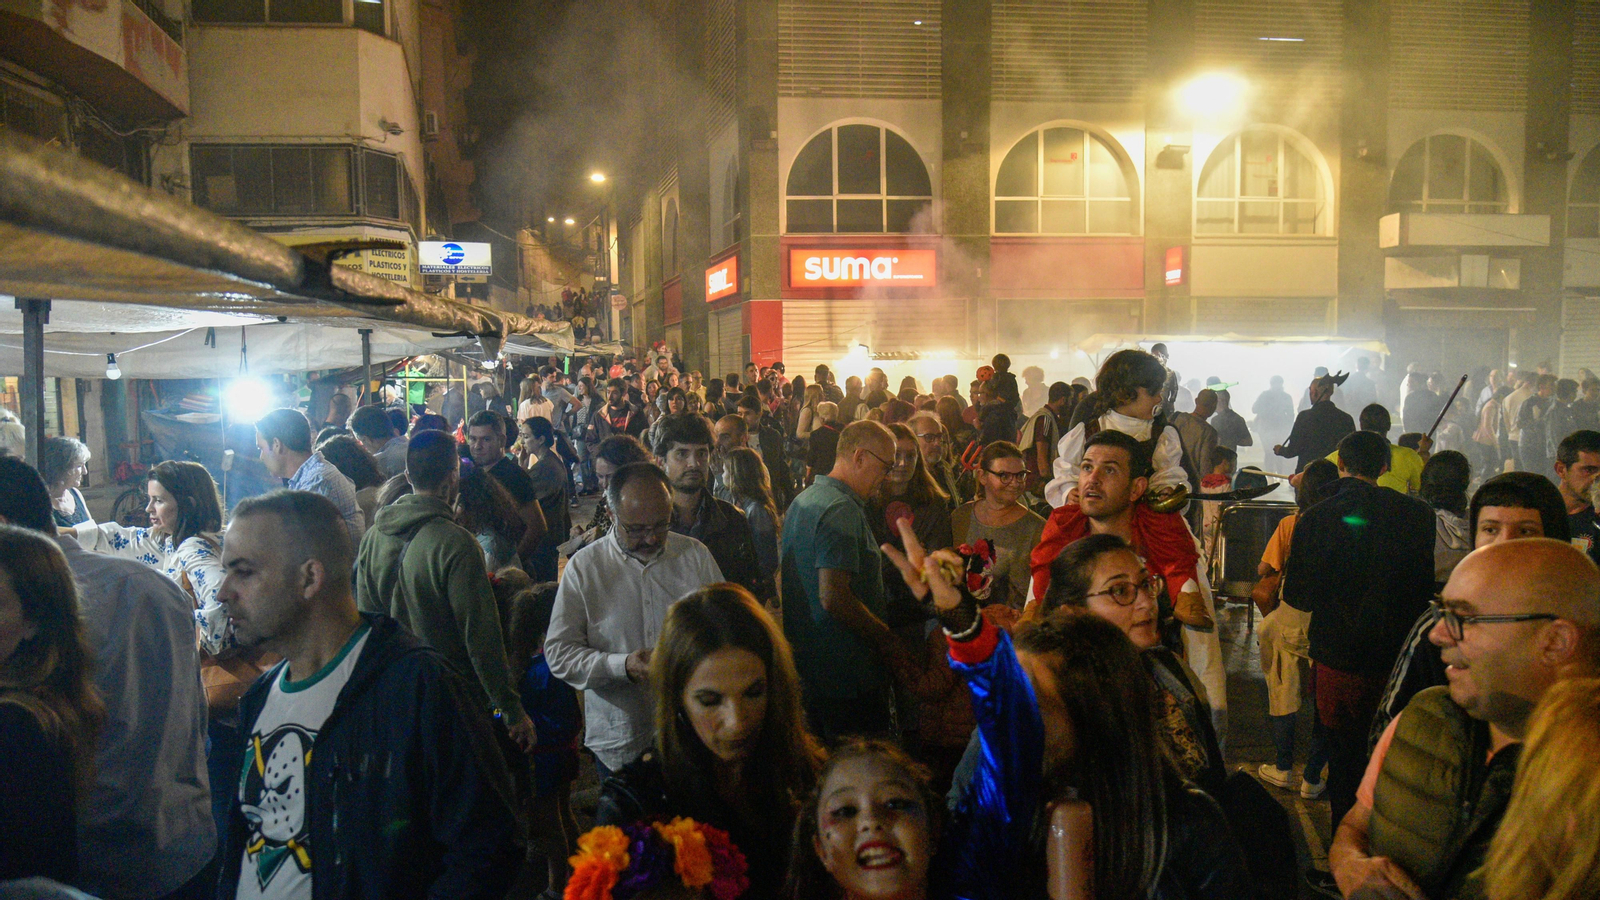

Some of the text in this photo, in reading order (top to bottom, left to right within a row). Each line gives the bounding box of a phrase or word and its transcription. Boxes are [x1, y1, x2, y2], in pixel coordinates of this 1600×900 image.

[371, 249, 406, 260] ELECTRICOS
[369, 260, 402, 270] PLASTICOS
[402, 263, 407, 271] Y
[804, 256, 892, 280] suma
